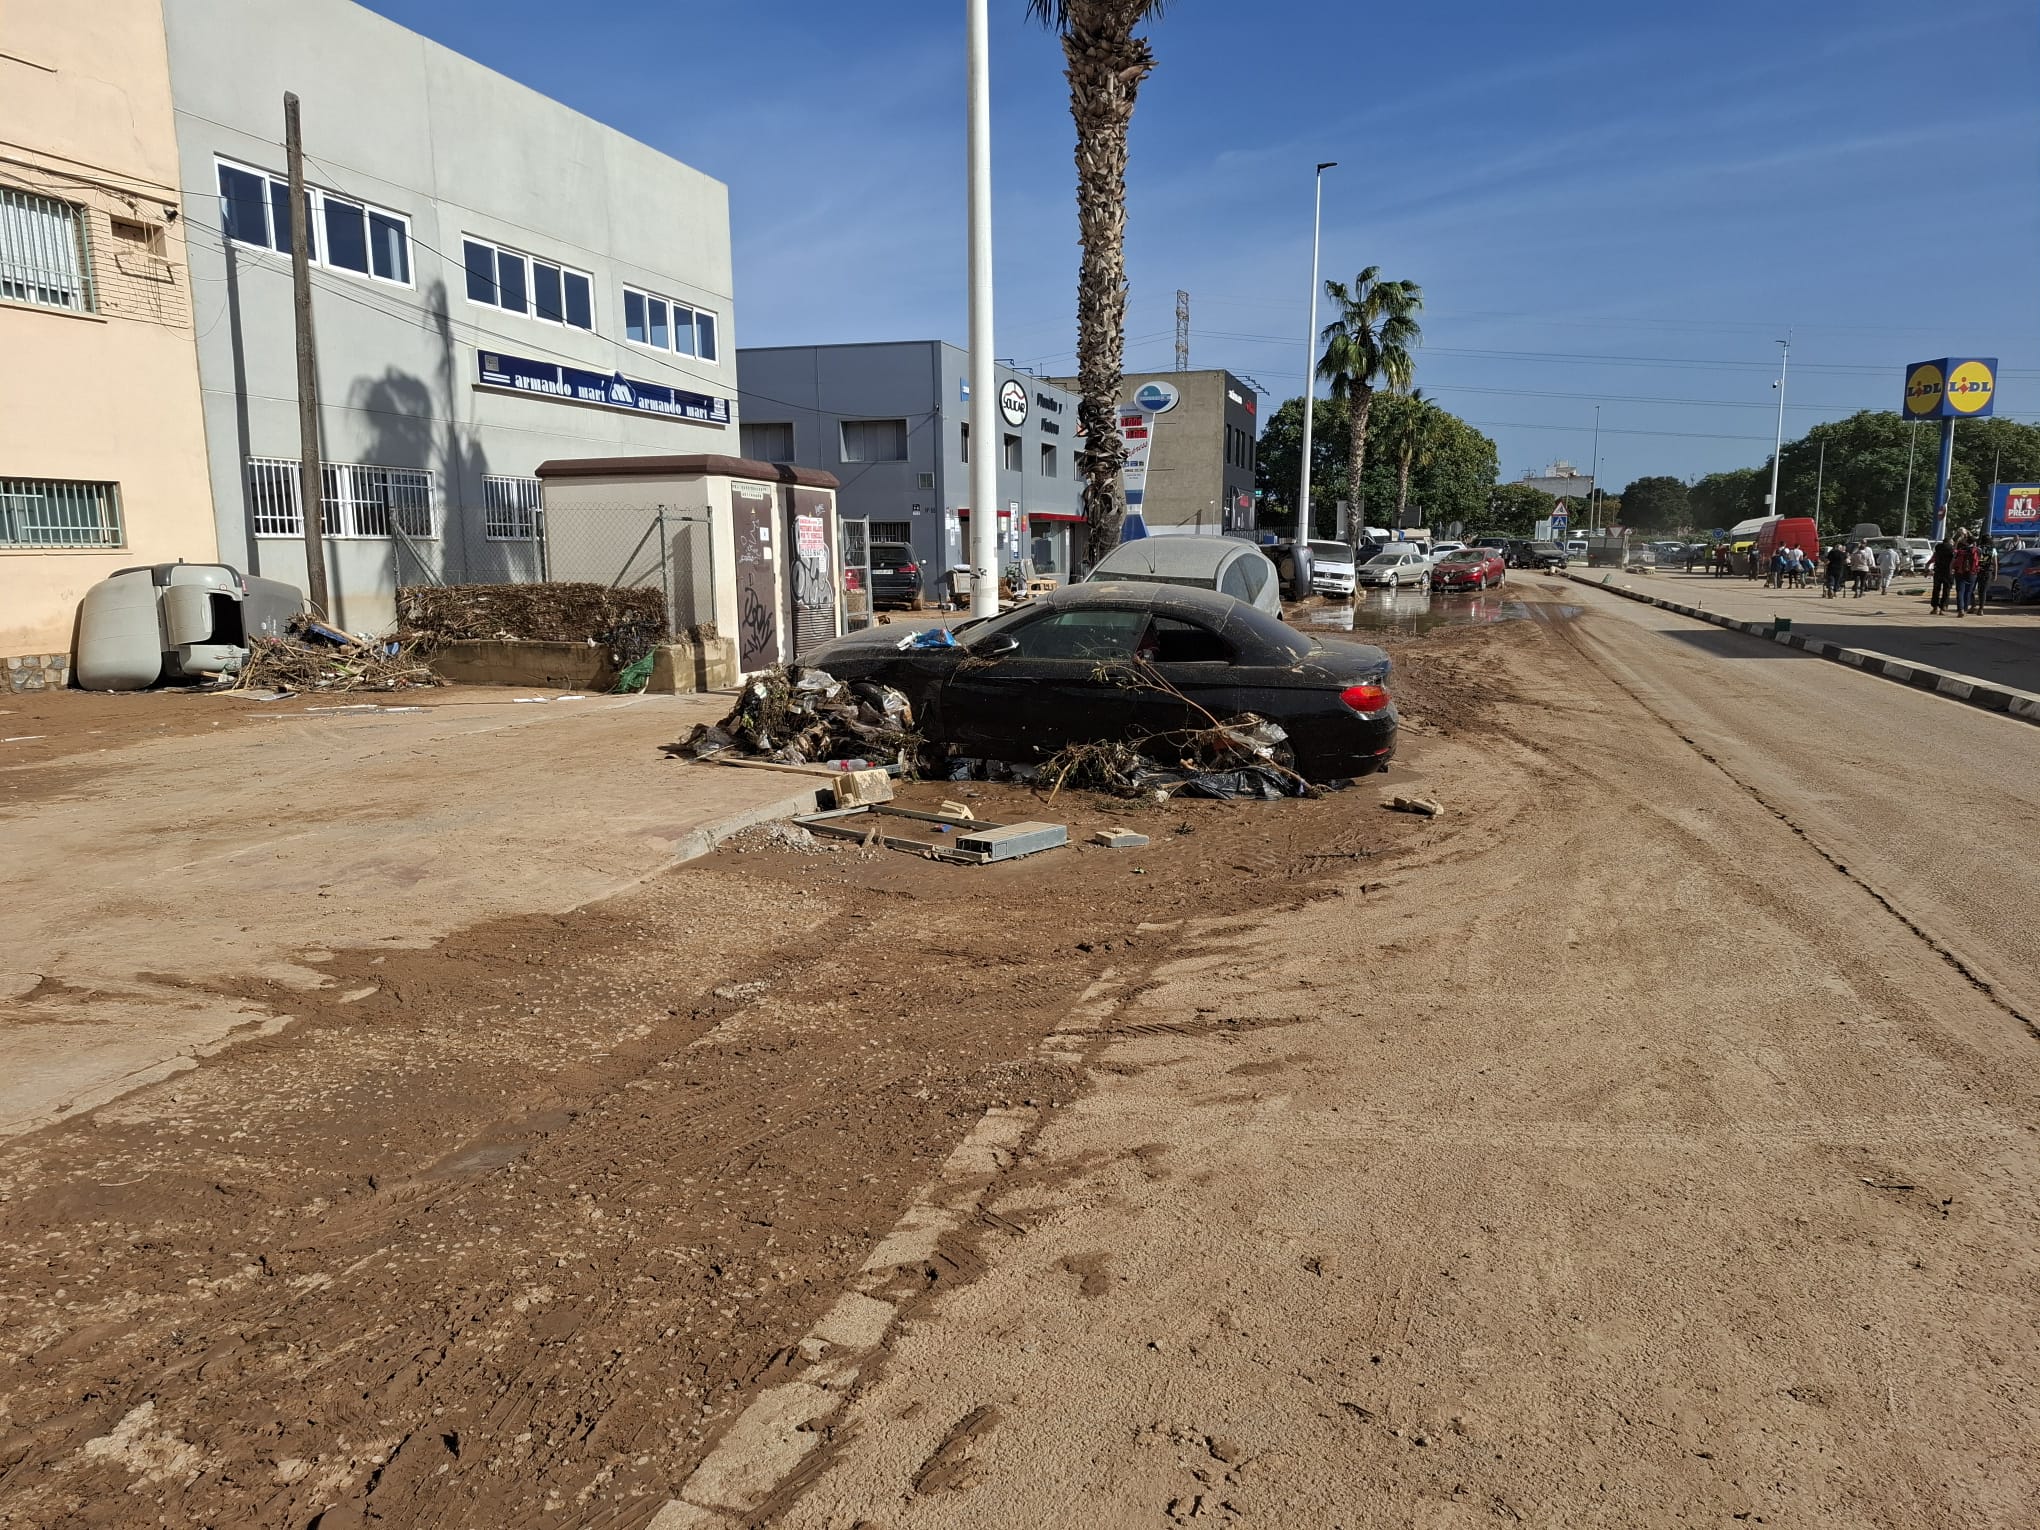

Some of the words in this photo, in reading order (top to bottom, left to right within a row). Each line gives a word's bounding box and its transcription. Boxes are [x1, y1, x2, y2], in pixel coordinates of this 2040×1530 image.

[515, 367, 572, 396] armando
[578, 380, 605, 402] marí
[638, 389, 682, 415] armando
[686, 401, 708, 420] marí
[2008, 508, 2037, 517] PRECIO
